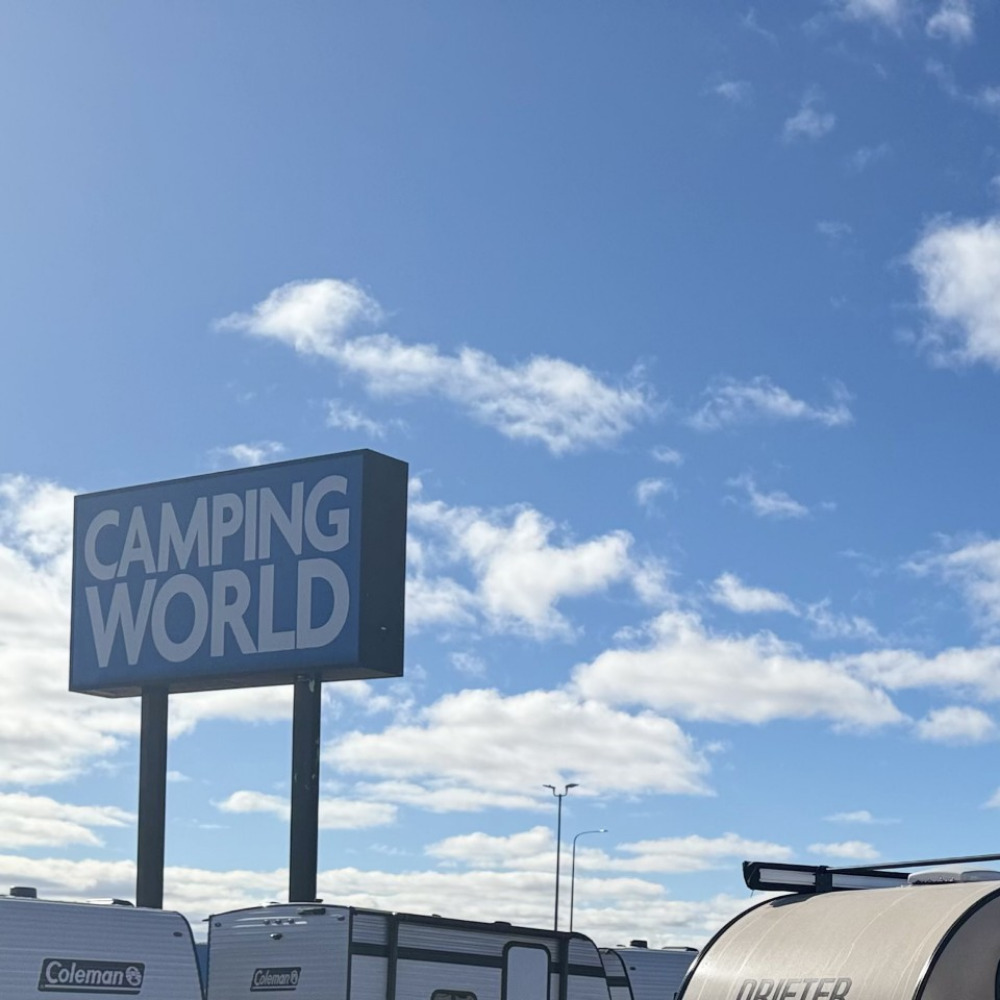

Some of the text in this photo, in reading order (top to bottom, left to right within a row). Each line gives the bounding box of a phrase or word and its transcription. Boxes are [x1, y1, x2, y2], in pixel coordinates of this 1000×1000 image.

[84, 475, 350, 580] CAMPING
[85, 558, 350, 668] WORLD
[45, 960, 124, 985] Coleman
[254, 969, 290, 986] Coleman
